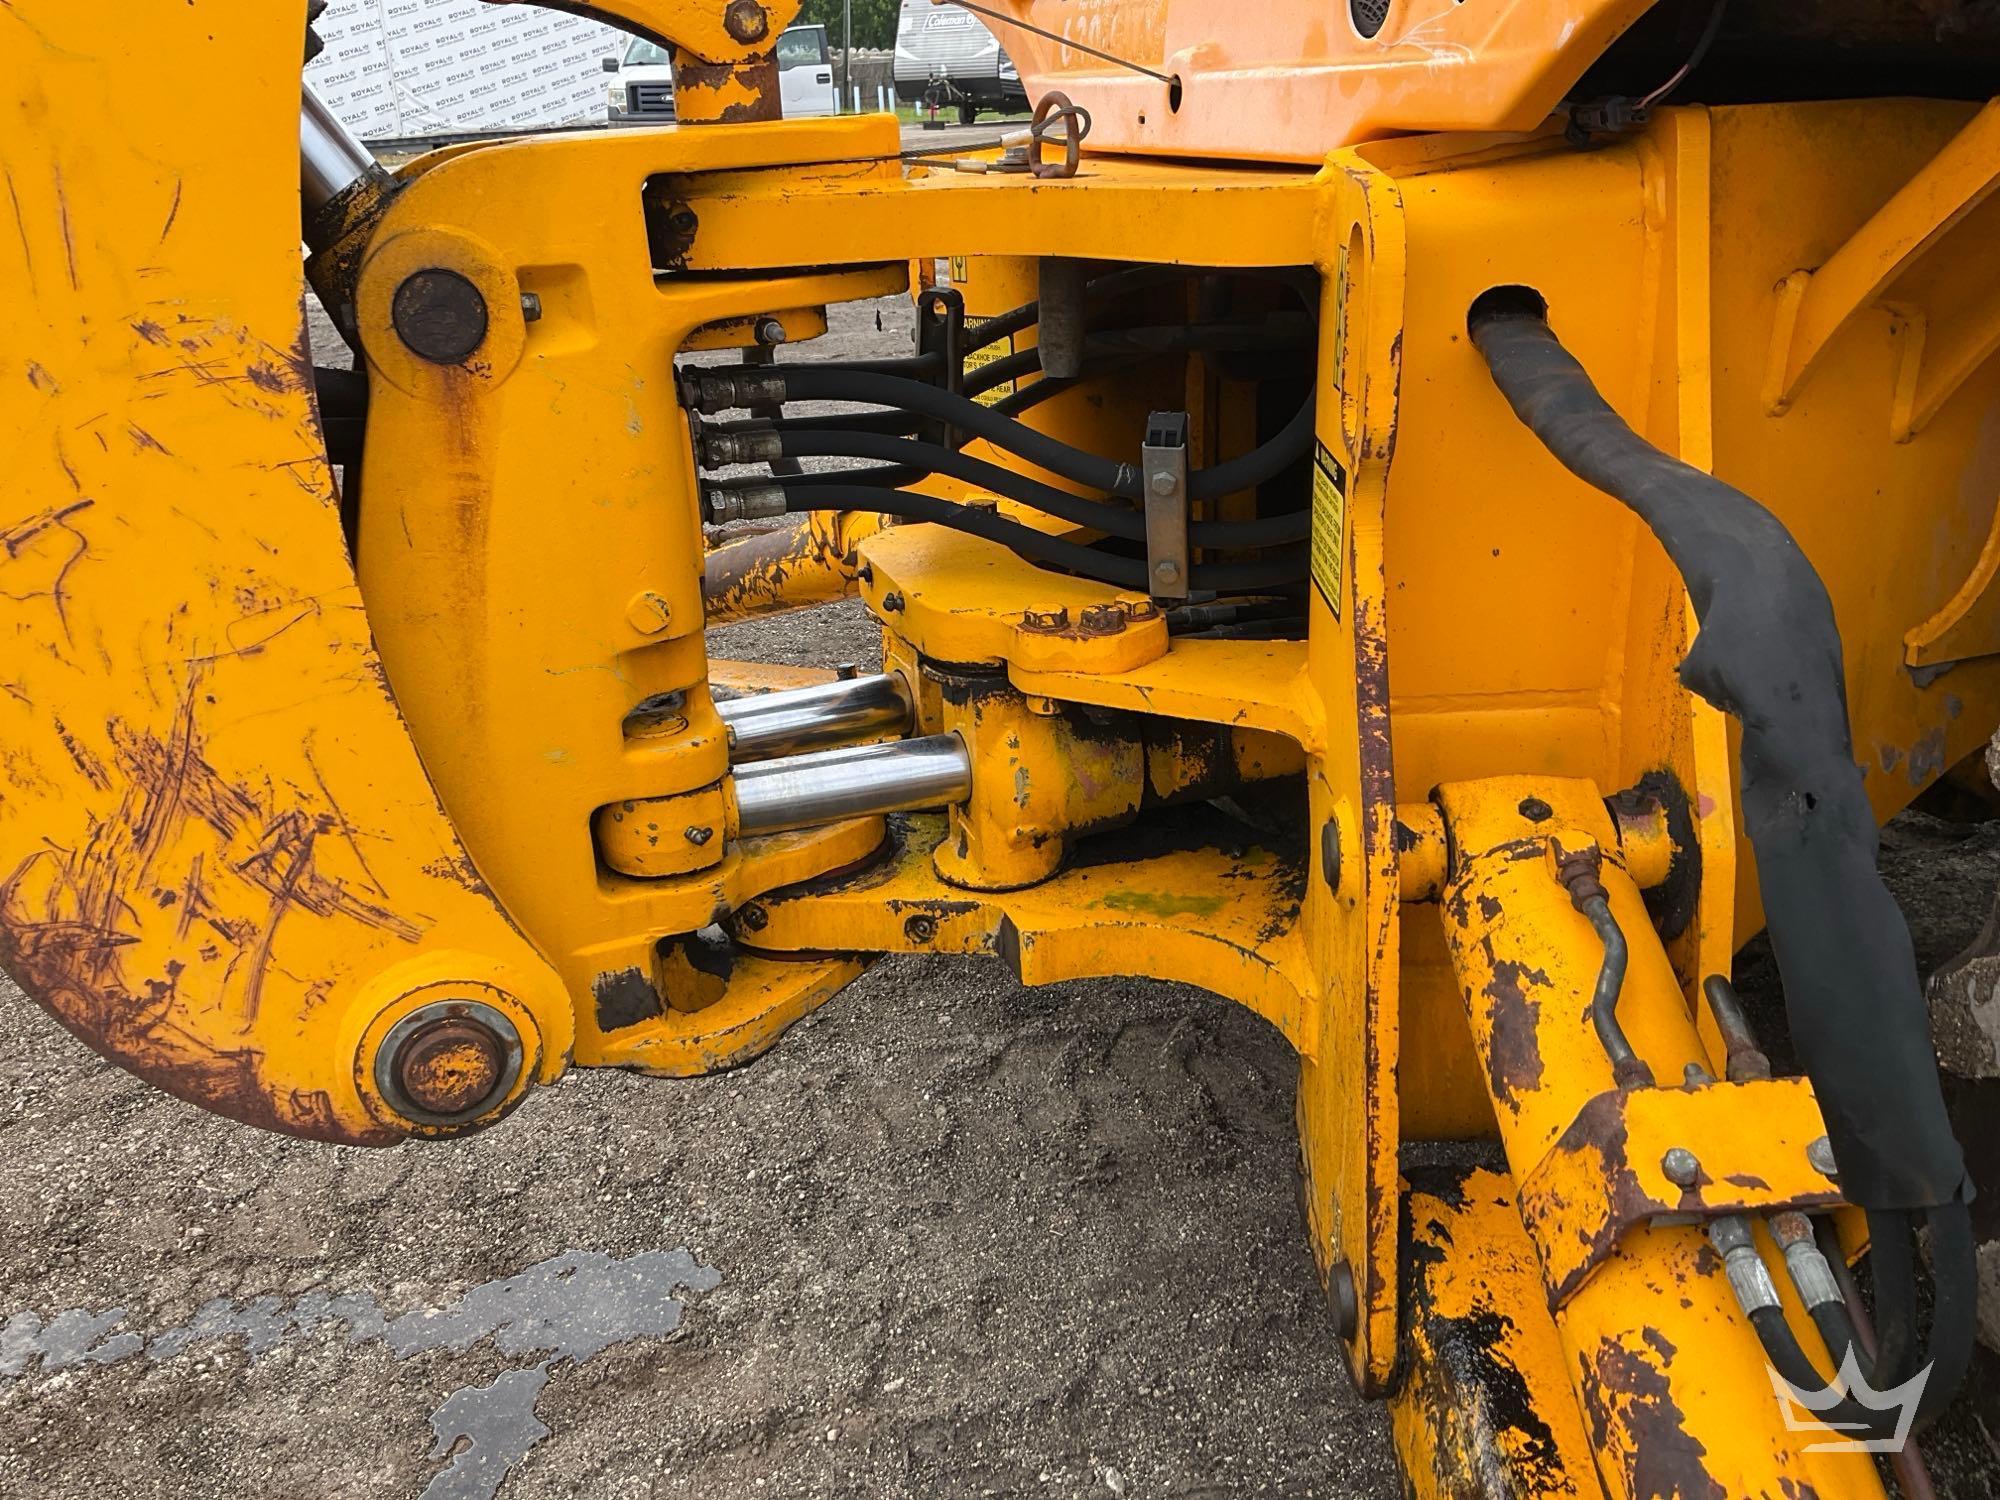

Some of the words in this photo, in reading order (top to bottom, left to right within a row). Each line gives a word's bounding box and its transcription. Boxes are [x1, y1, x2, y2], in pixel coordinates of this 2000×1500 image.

[326, 5, 351, 16] ROYAL
[388, 6, 411, 14] ROYAL
[448, 9, 470, 19] ROYAL
[502, 15, 520, 24] ROYAL
[554, 20, 572, 28] ROYAL
[928, 14, 965, 26] Coleman
[350, 23, 374, 32] ROYAL
[413, 20, 436, 29] ROYAL
[470, 25, 490, 34] ROYAL
[523, 29, 543, 38] ROYAL
[436, 35, 457, 44] ROYAL
[572, 33, 590, 41] ROYAL
[492, 38, 512, 47] ROYAL
[542, 42, 561, 51] ROYAL
[339, 47, 363, 57] ROYAL
[400, 45, 423, 55] ROYAL
[460, 48, 481, 57] ROYAL
[592, 45, 609, 54] ROYAL
[512, 52, 531, 61] ROYAL
[563, 54, 581, 64] ROYAL
[363, 61, 387, 72] ROYAL
[425, 59, 446, 68] ROYAL
[480, 61, 500, 71] ROYAL
[394, 69, 411, 78] OYAL
[533, 65, 550, 73] ROYAL
[581, 67, 598, 76] ROYAL
[324, 73, 348, 84] ROYAL
[446, 72, 468, 82] ROYAL
[502, 75, 521, 84] ROYAL
[552, 78, 570, 86] ROYAL
[350, 87, 374, 98] ROYAL
[412, 83, 434, 93] ROYAL
[470, 85, 490, 95] ROYAL
[521, 88, 541, 97] ROYAL
[572, 90, 590, 98] ROYAL
[436, 96, 458, 106] ROYAL
[490, 99, 510, 108] ROYAL
[542, 101, 561, 109] ROYAL
[374, 102, 394, 112] ROYA
[590, 102, 607, 110] ROYAL
[341, 112, 361, 123] OYAL
[400, 108, 422, 118] ROYAL
[457, 110, 478, 120] ROYAL
[512, 111, 530, 120] ROYAL
[561, 113, 580, 121] ROYAL
[423, 122, 445, 131] ROYAL
[363, 126, 386, 137] ROYAL
